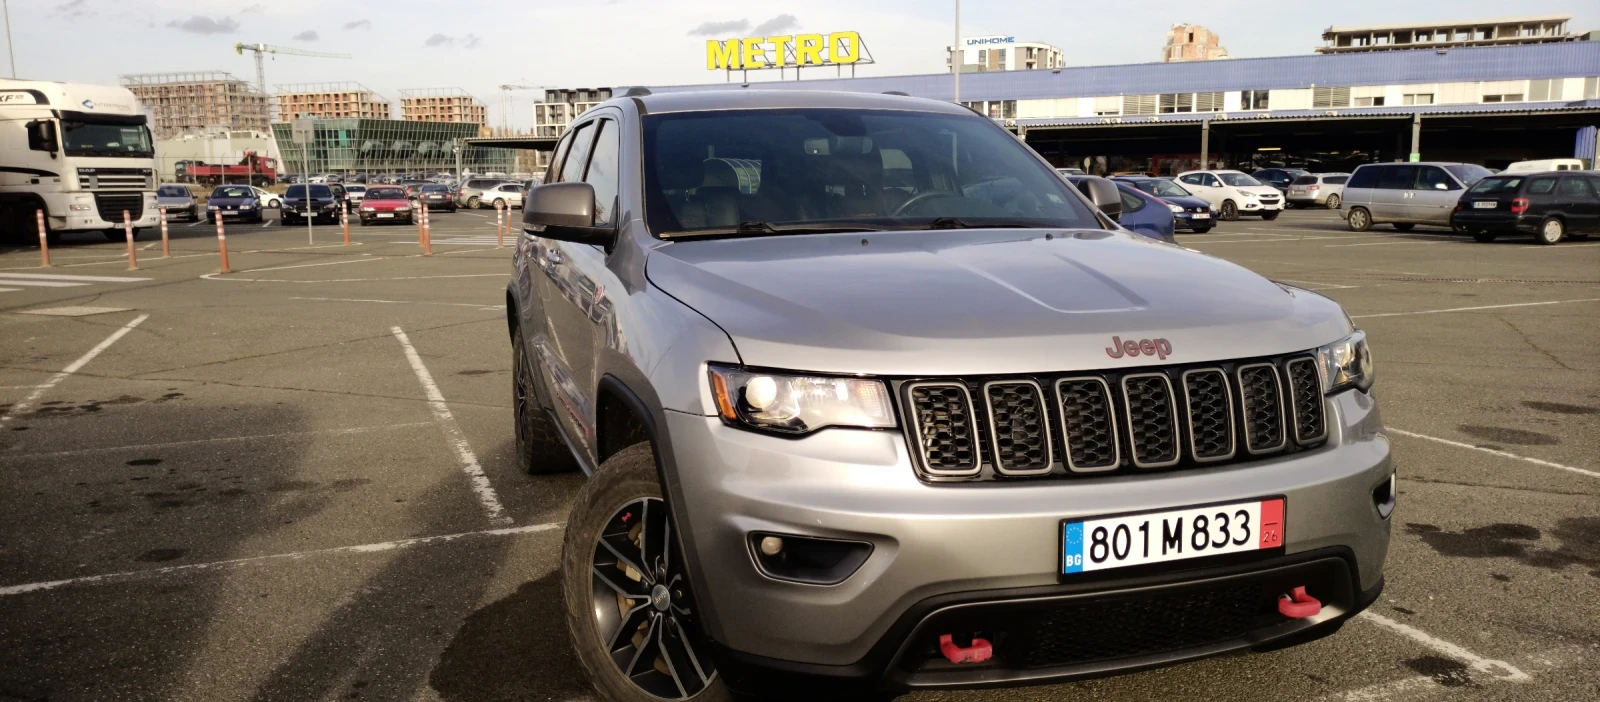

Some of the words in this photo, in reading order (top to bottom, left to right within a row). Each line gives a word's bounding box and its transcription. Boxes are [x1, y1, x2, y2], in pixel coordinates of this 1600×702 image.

[967, 37, 1015, 45] UNIHOME
[706, 31, 860, 70] METRO
[1105, 336, 1172, 360] Jeep
[1089, 521, 1150, 564] 801
[1162, 517, 1183, 556] M
[1191, 509, 1251, 551] 833
[1263, 531, 1278, 543] 26
[1066, 554, 1082, 567] BG
